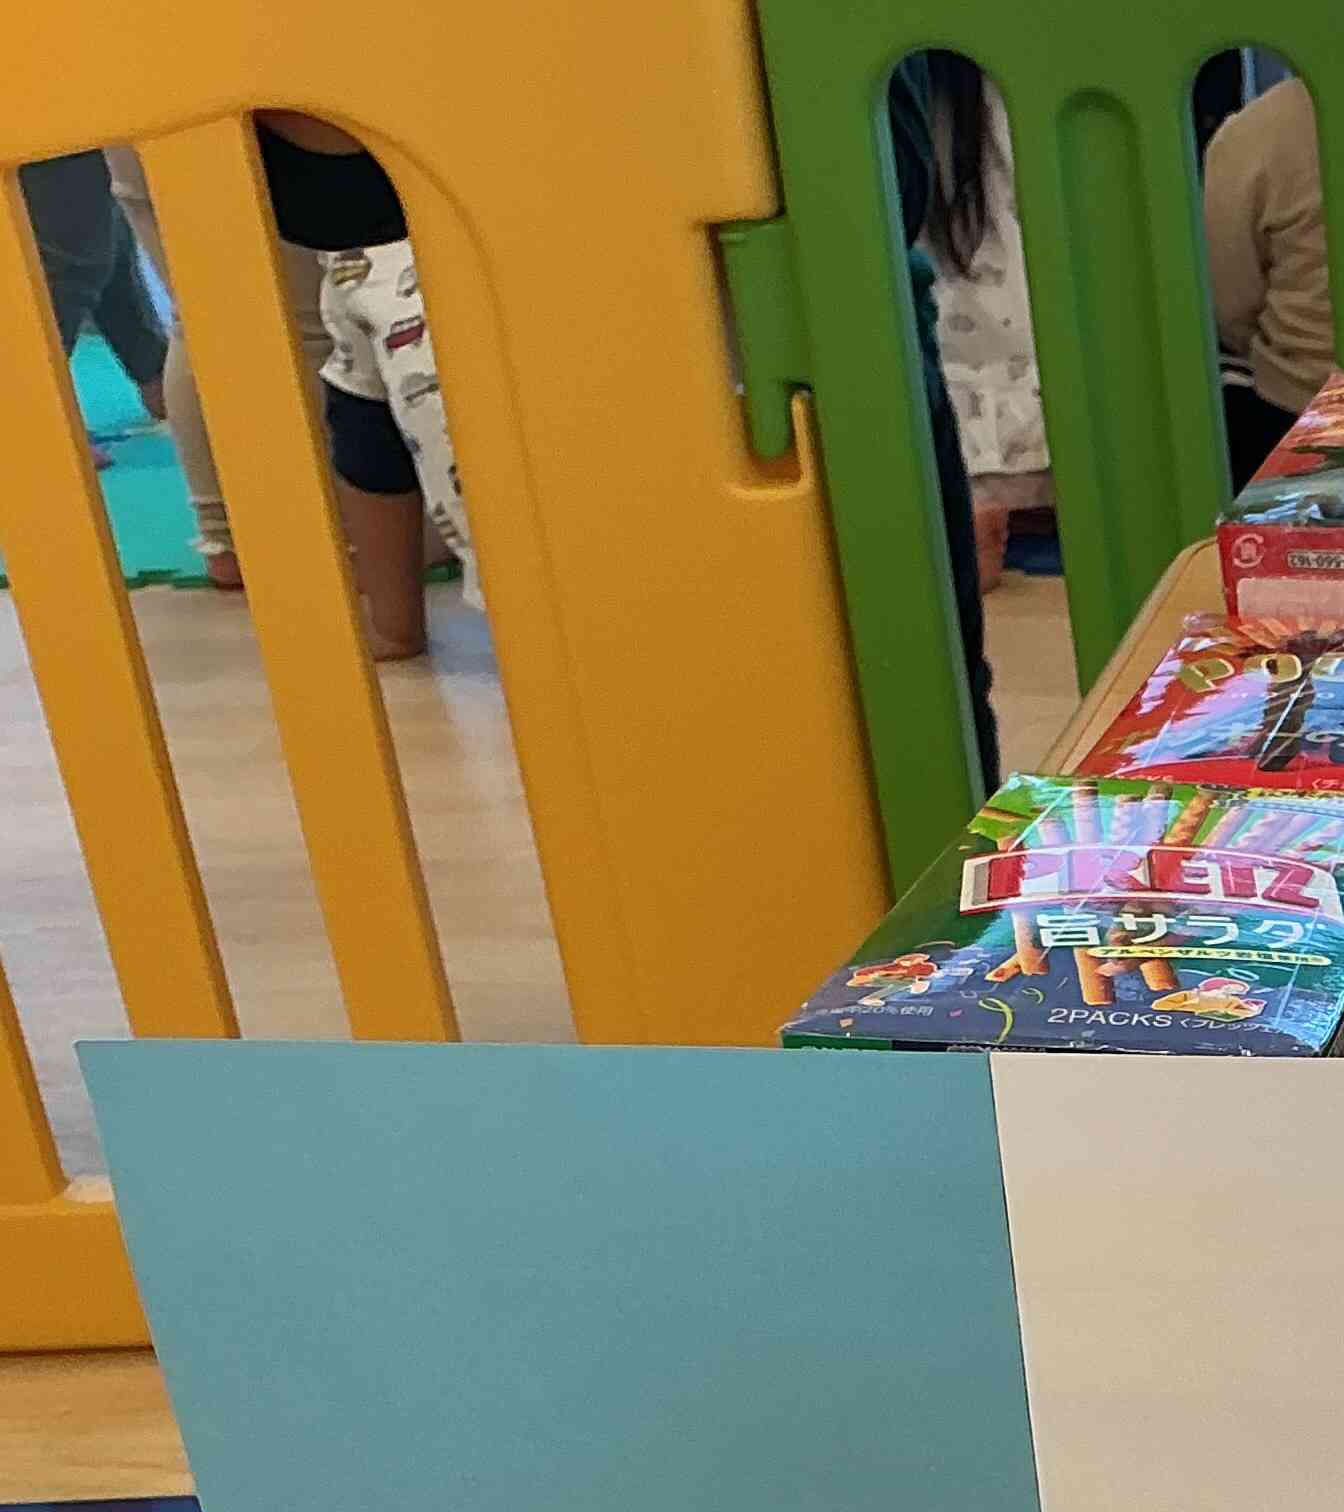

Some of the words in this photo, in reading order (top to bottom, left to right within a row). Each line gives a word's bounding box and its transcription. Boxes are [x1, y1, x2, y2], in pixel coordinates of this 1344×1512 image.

[1034, 911, 1332, 950] 旨サラダ
[1047, 1007, 1173, 1028] 2PACKS
